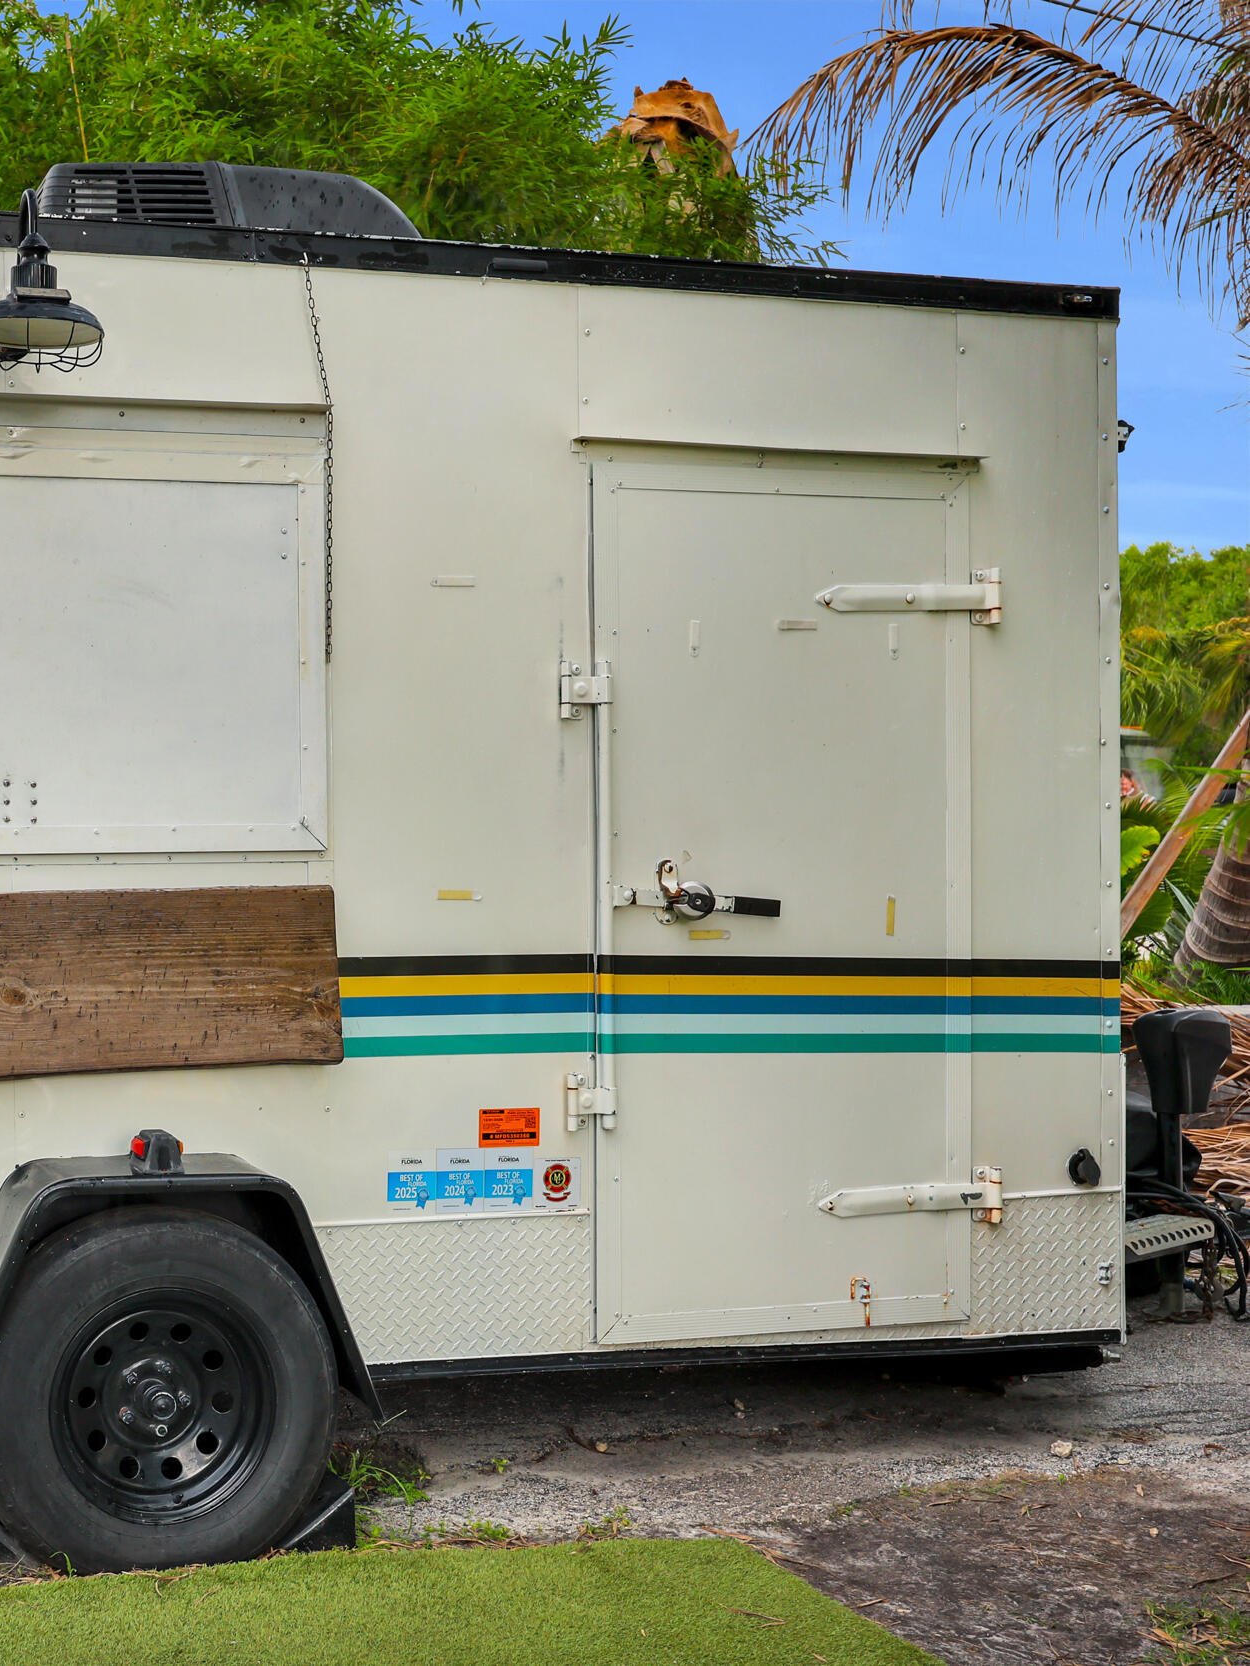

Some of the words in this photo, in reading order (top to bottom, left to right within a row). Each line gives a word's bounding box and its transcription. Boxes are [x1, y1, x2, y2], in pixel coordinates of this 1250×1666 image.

[400, 1174, 414, 1182] BEST
[395, 1187, 417, 1199] 2025
[444, 1185, 465, 1196] 2024
[492, 1184, 514, 1195] 2023
